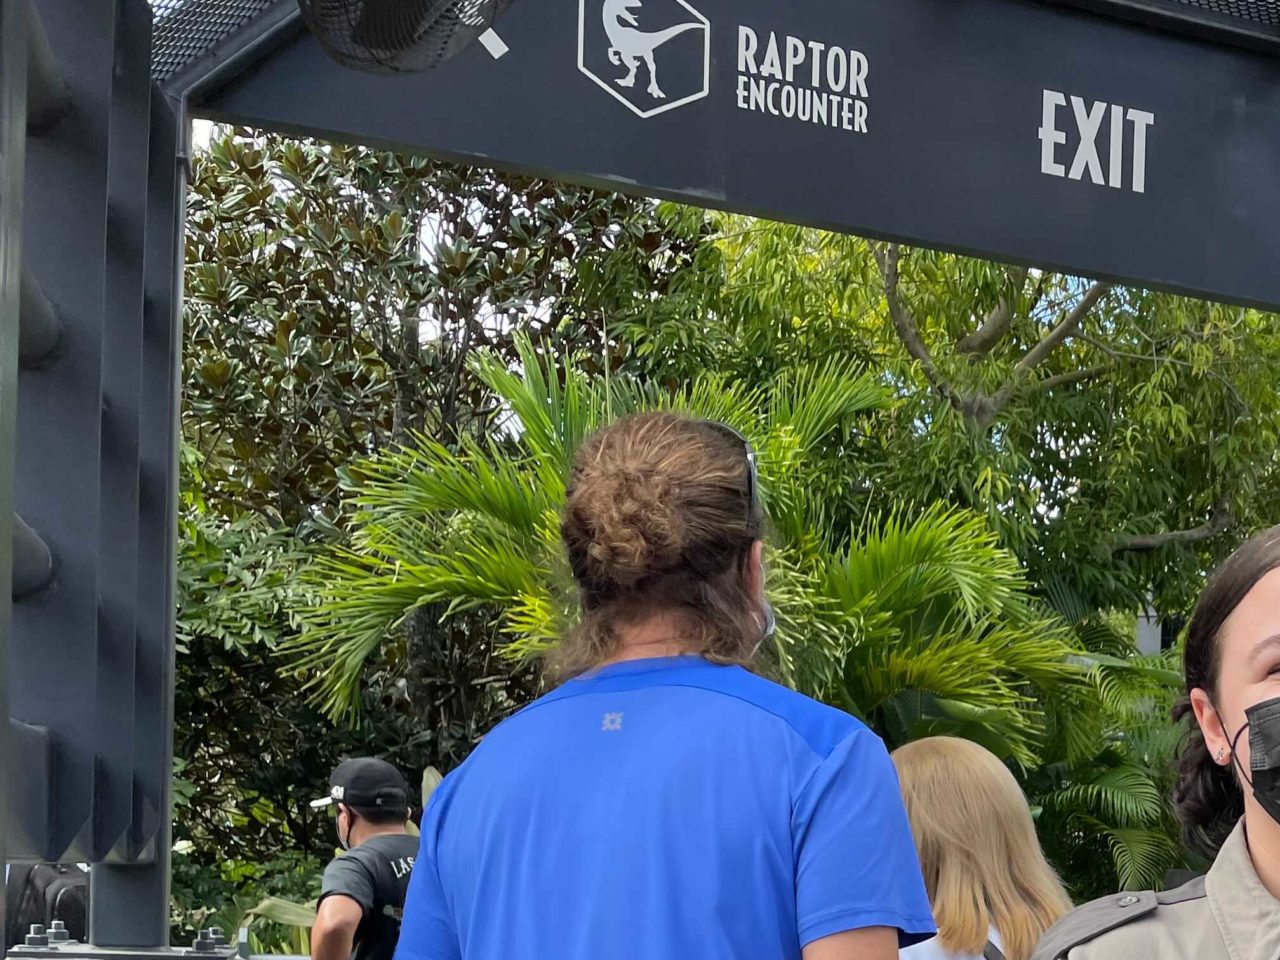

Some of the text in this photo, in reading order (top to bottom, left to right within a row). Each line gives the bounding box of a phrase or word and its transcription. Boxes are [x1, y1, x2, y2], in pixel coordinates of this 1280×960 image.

[737, 25, 869, 97] RAPTOR
[736, 75, 868, 133] ENCOUNTER
[1038, 89, 1155, 193] EXIT
